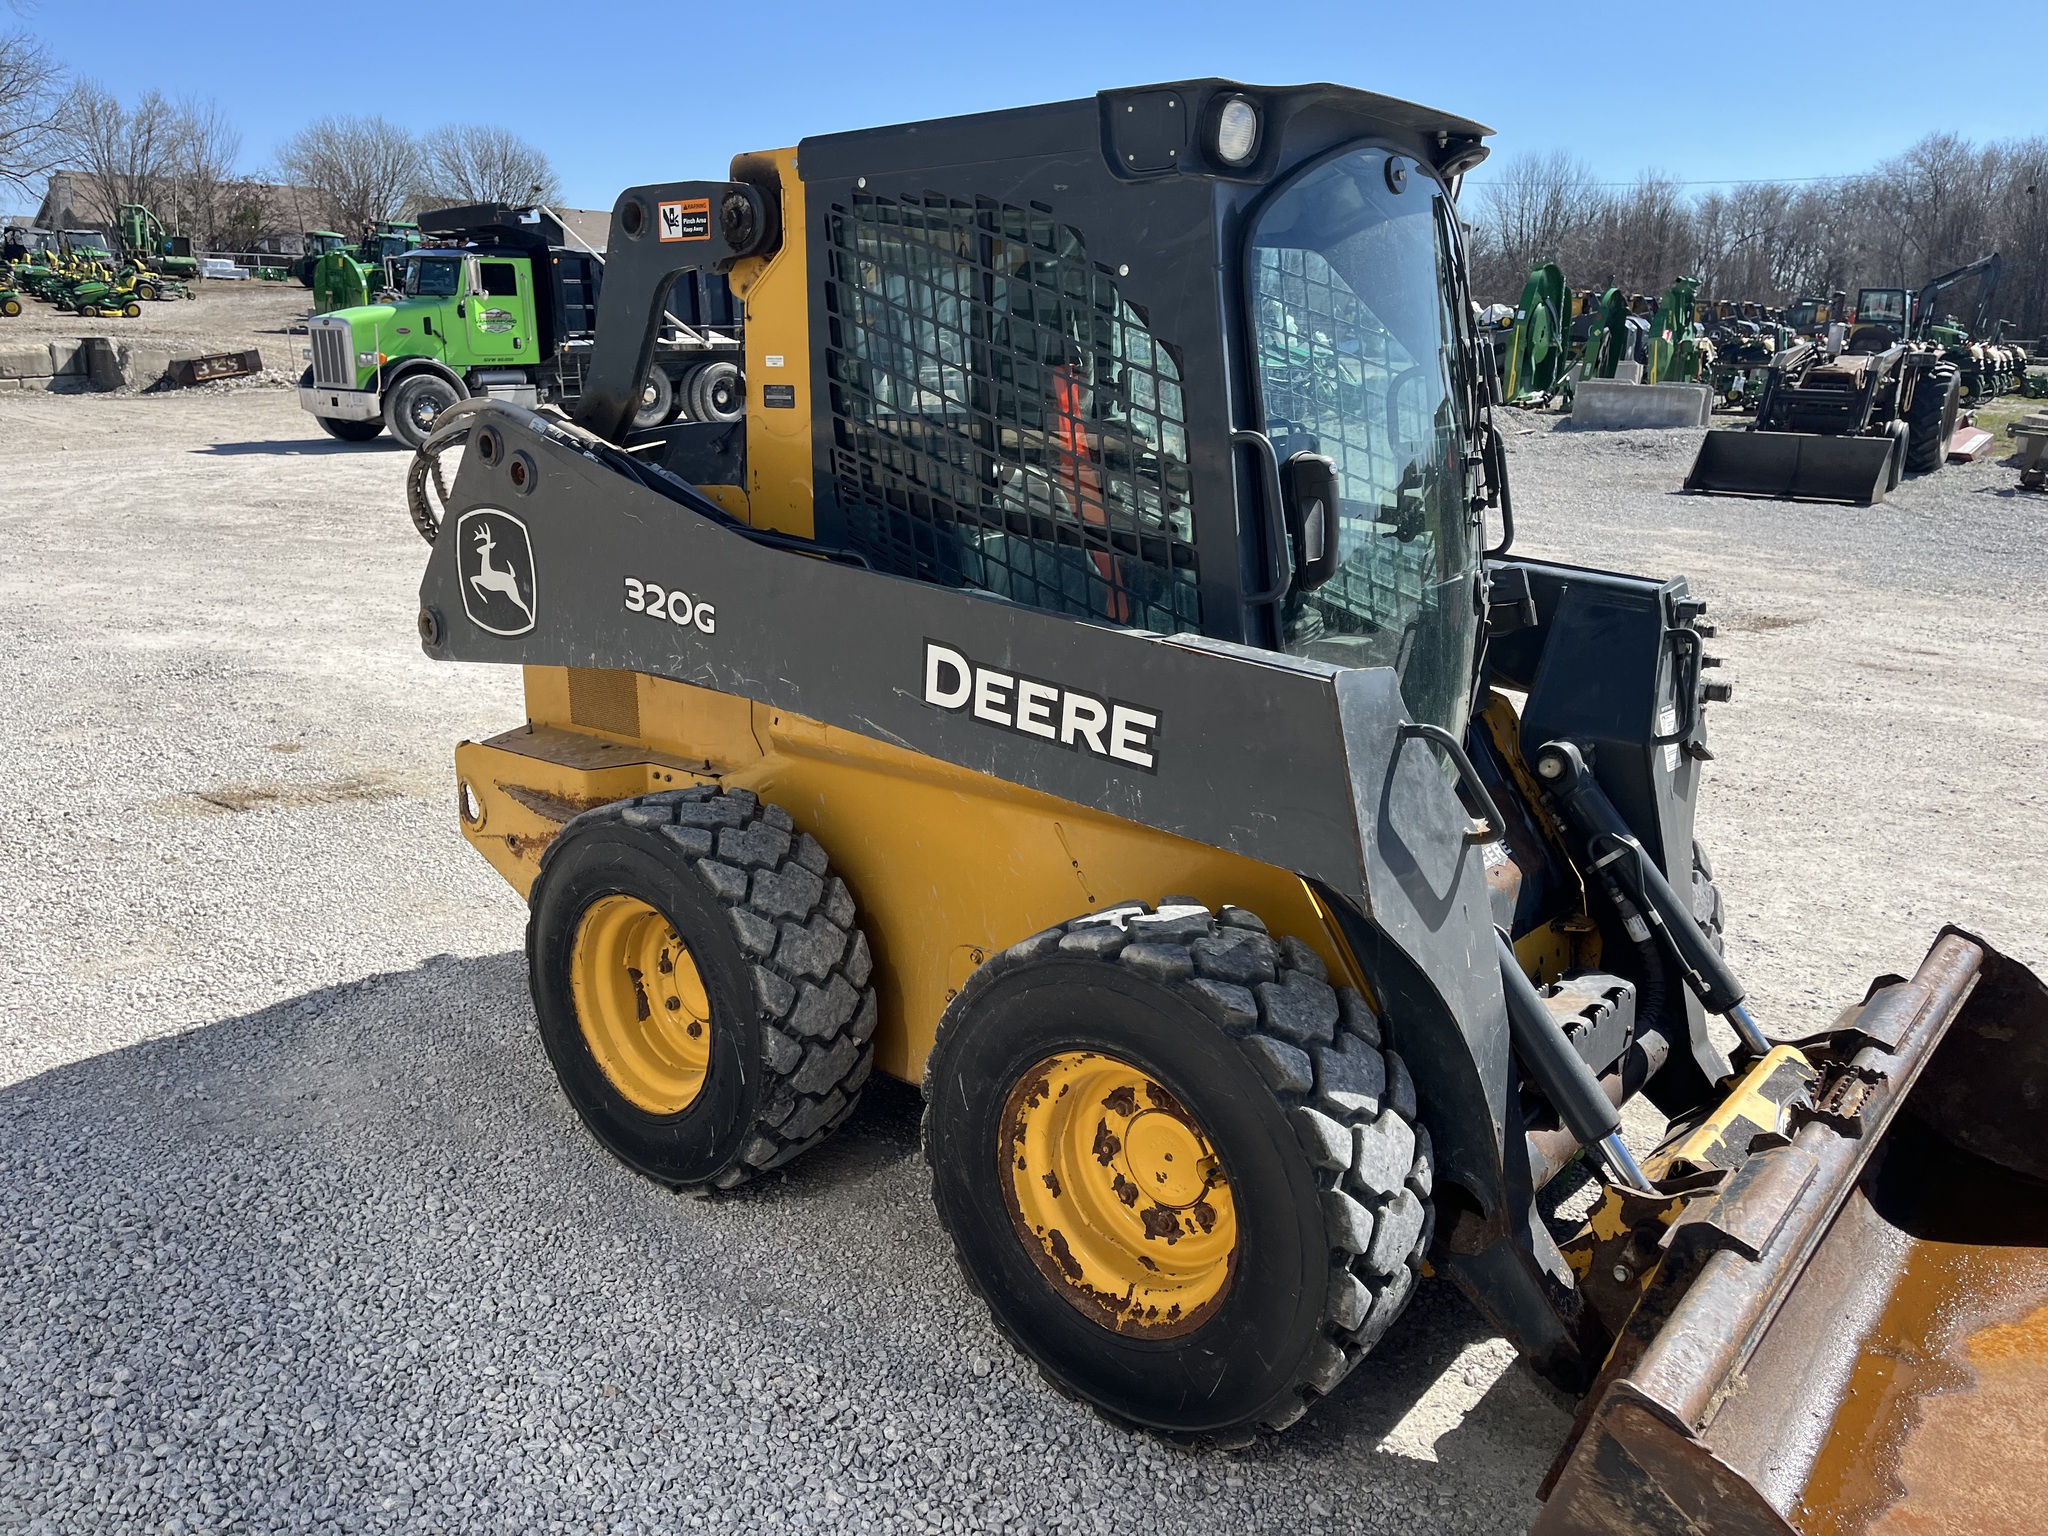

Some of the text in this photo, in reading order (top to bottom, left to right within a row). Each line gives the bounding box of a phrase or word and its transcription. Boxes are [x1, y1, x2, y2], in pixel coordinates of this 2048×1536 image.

[625, 578, 715, 634] 320G
[926, 643, 1157, 768] DEERE
[1482, 838, 1512, 869] EERE
